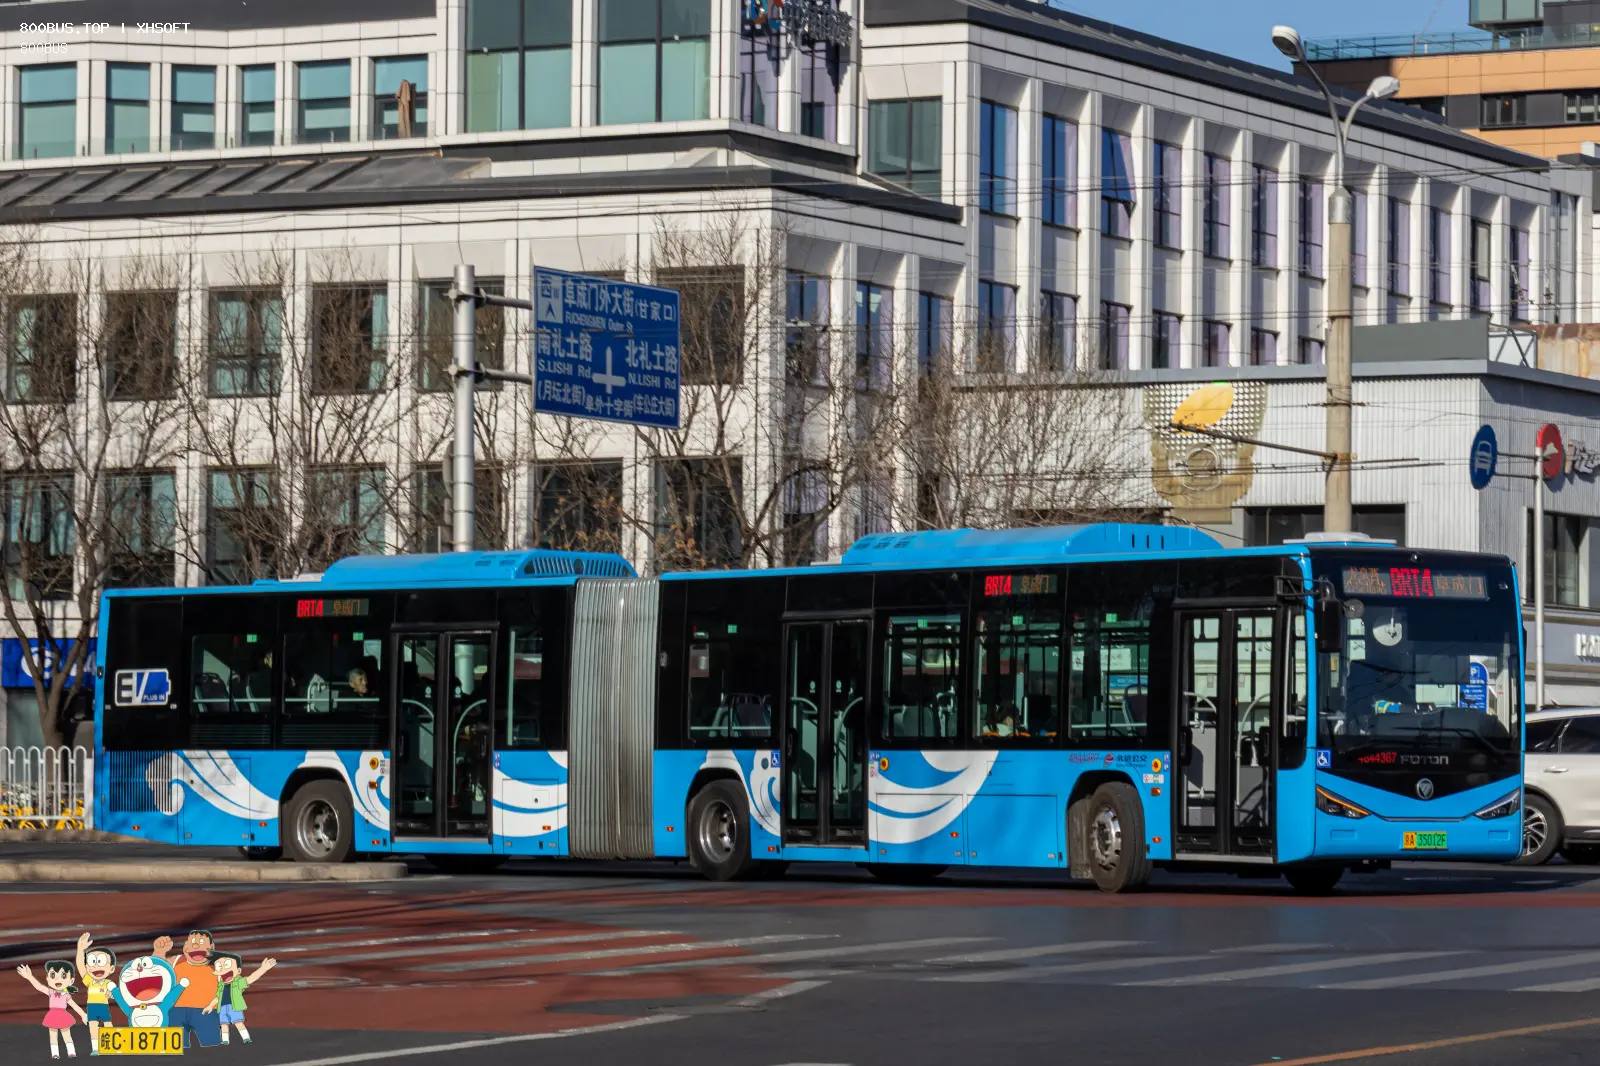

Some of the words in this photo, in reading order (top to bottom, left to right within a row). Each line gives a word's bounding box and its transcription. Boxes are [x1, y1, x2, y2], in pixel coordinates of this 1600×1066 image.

[537, 325, 593, 363] 南礼士路
[625, 339, 678, 374] 北礼士路
[577, 364, 592, 380] Rd
[628, 372, 661, 389] N.LISHI
[664, 377, 677, 391] Rd
[984, 574, 1013, 597] BRT4
[1389, 567, 1435, 597] BRT4
[1436, 573, 1485, 596] 阜成门
[297, 599, 324, 618] BRT4
